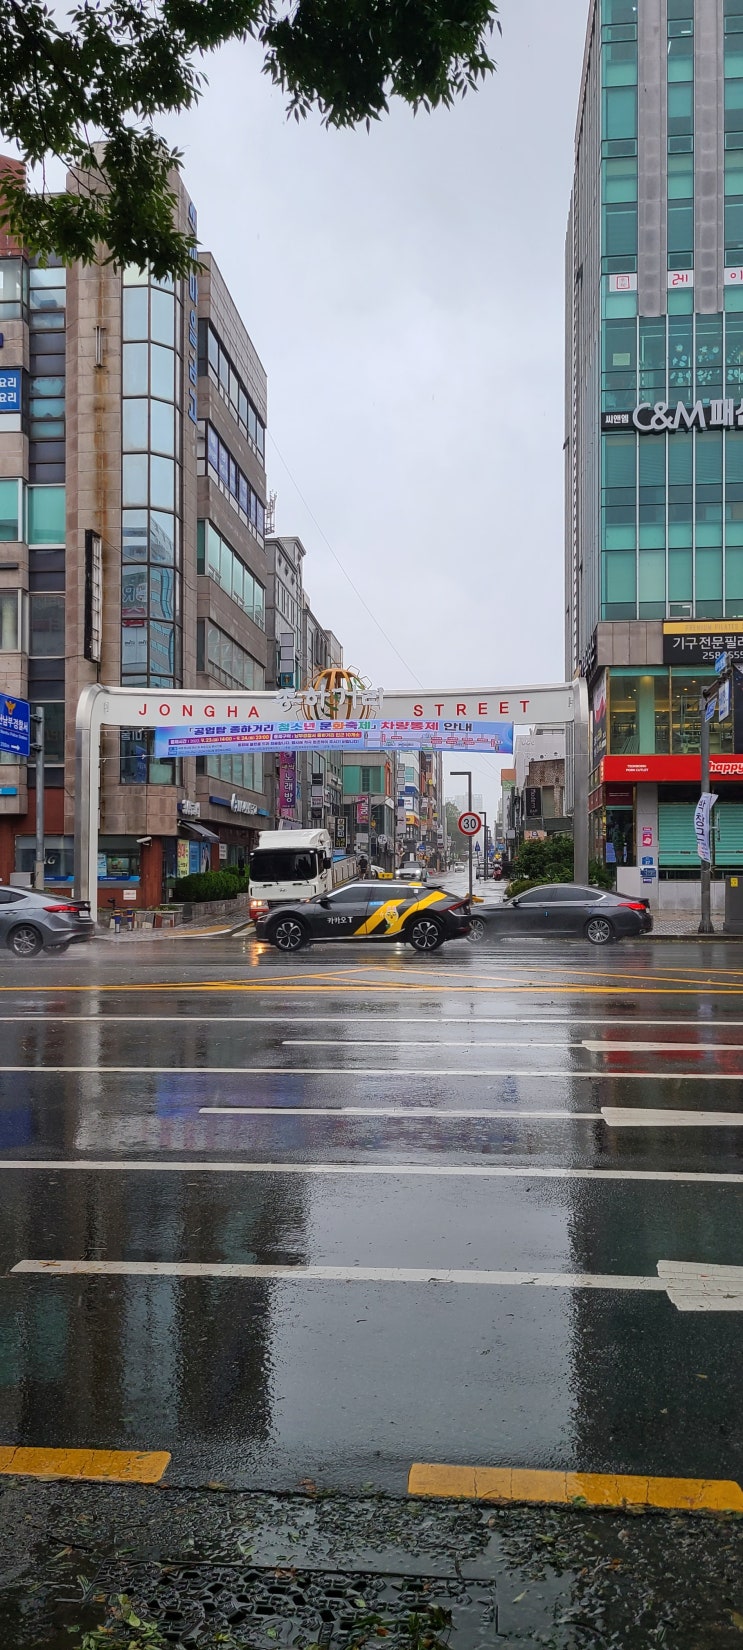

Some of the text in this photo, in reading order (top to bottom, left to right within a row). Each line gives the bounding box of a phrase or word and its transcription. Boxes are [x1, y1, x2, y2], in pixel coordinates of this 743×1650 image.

[605, 413, 629, 424] 씨앤엠
[632, 399, 707, 431] C&M
[273, 679, 385, 712] 종하거리
[138, 700, 530, 718] JONGHA STREET
[230, 724, 274, 733] 종하거리
[278, 722, 315, 731] 청소년
[380, 721, 439, 730] 차량통제
[444, 722, 473, 732] 안내
[284, 772, 293, 803] 노래방
[463, 818, 477, 829] 30
